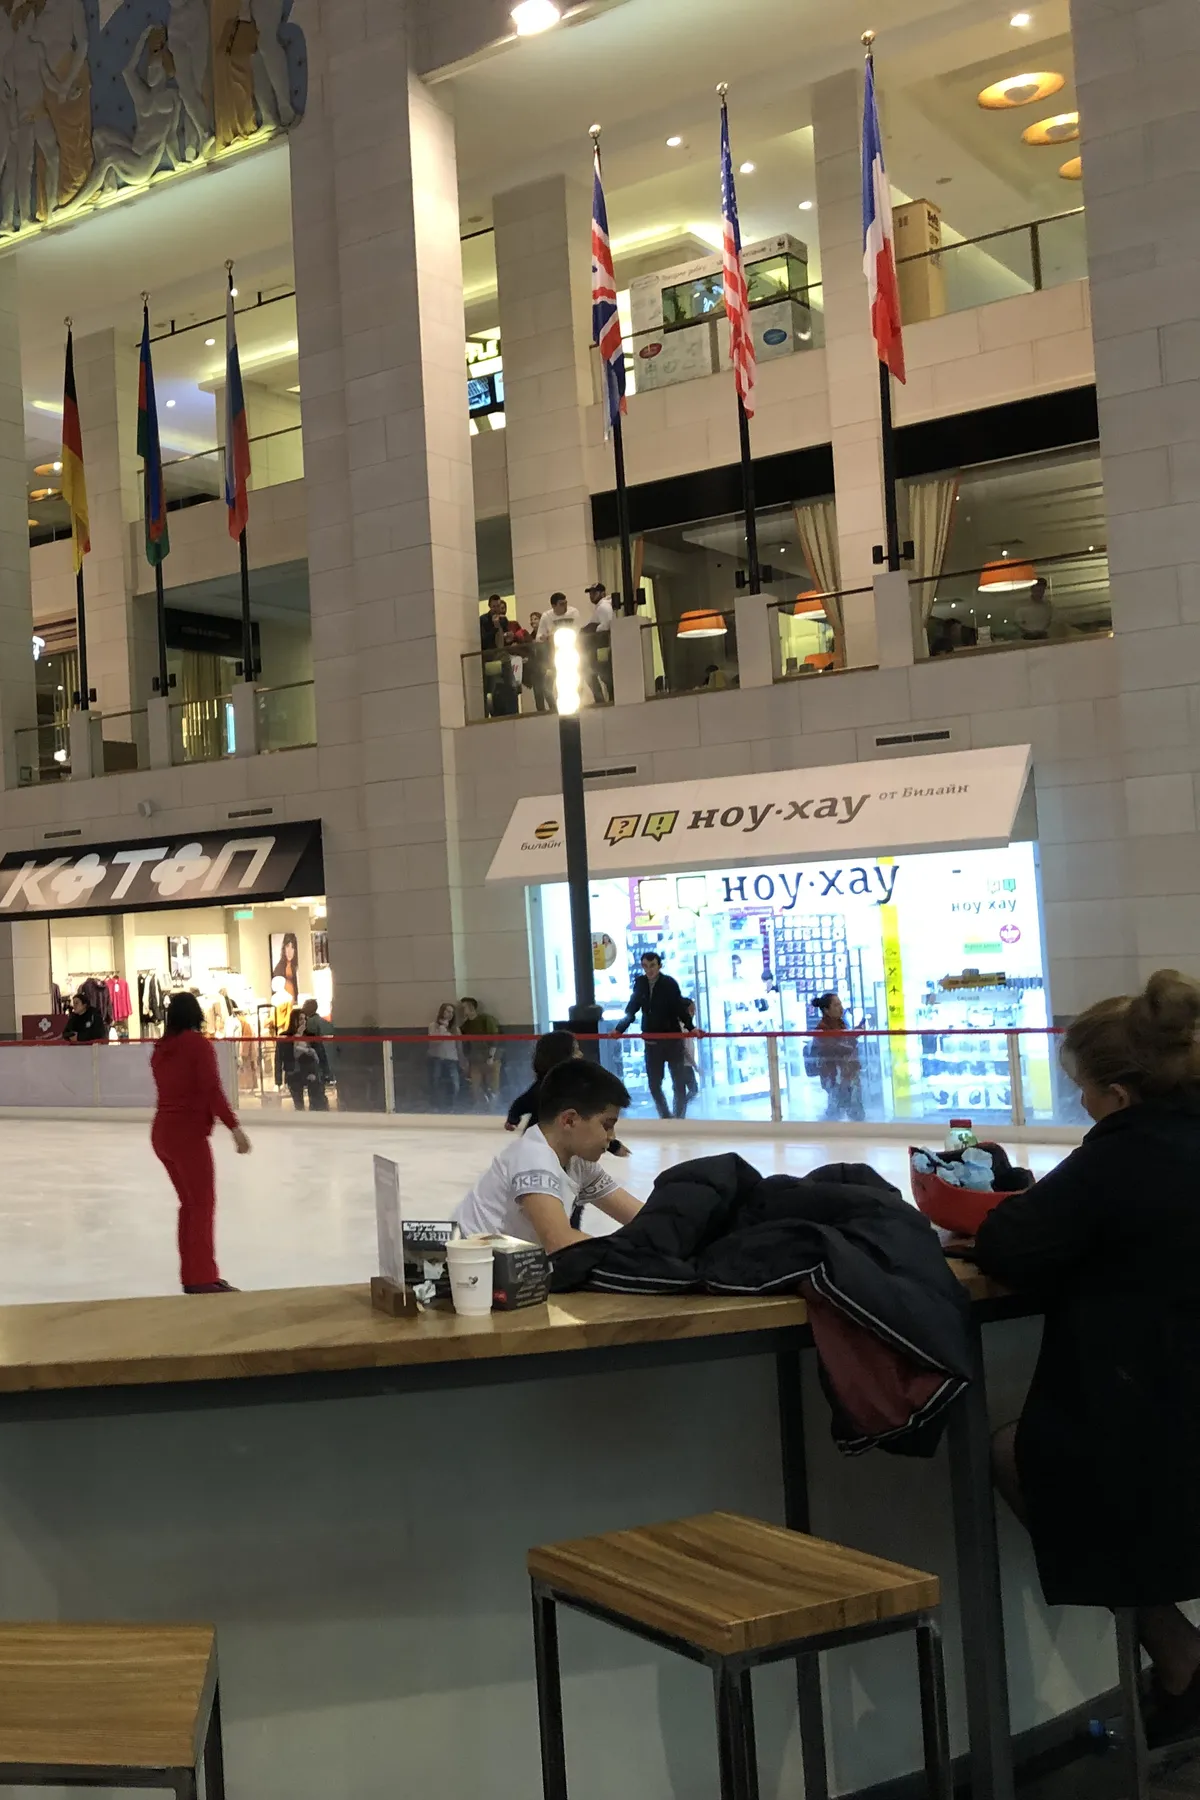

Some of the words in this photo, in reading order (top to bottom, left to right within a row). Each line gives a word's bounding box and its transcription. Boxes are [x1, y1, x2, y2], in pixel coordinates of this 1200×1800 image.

[878, 790, 898, 801] от
[902, 784, 969, 799] Билайн
[521, 840, 562, 851] Билайн
